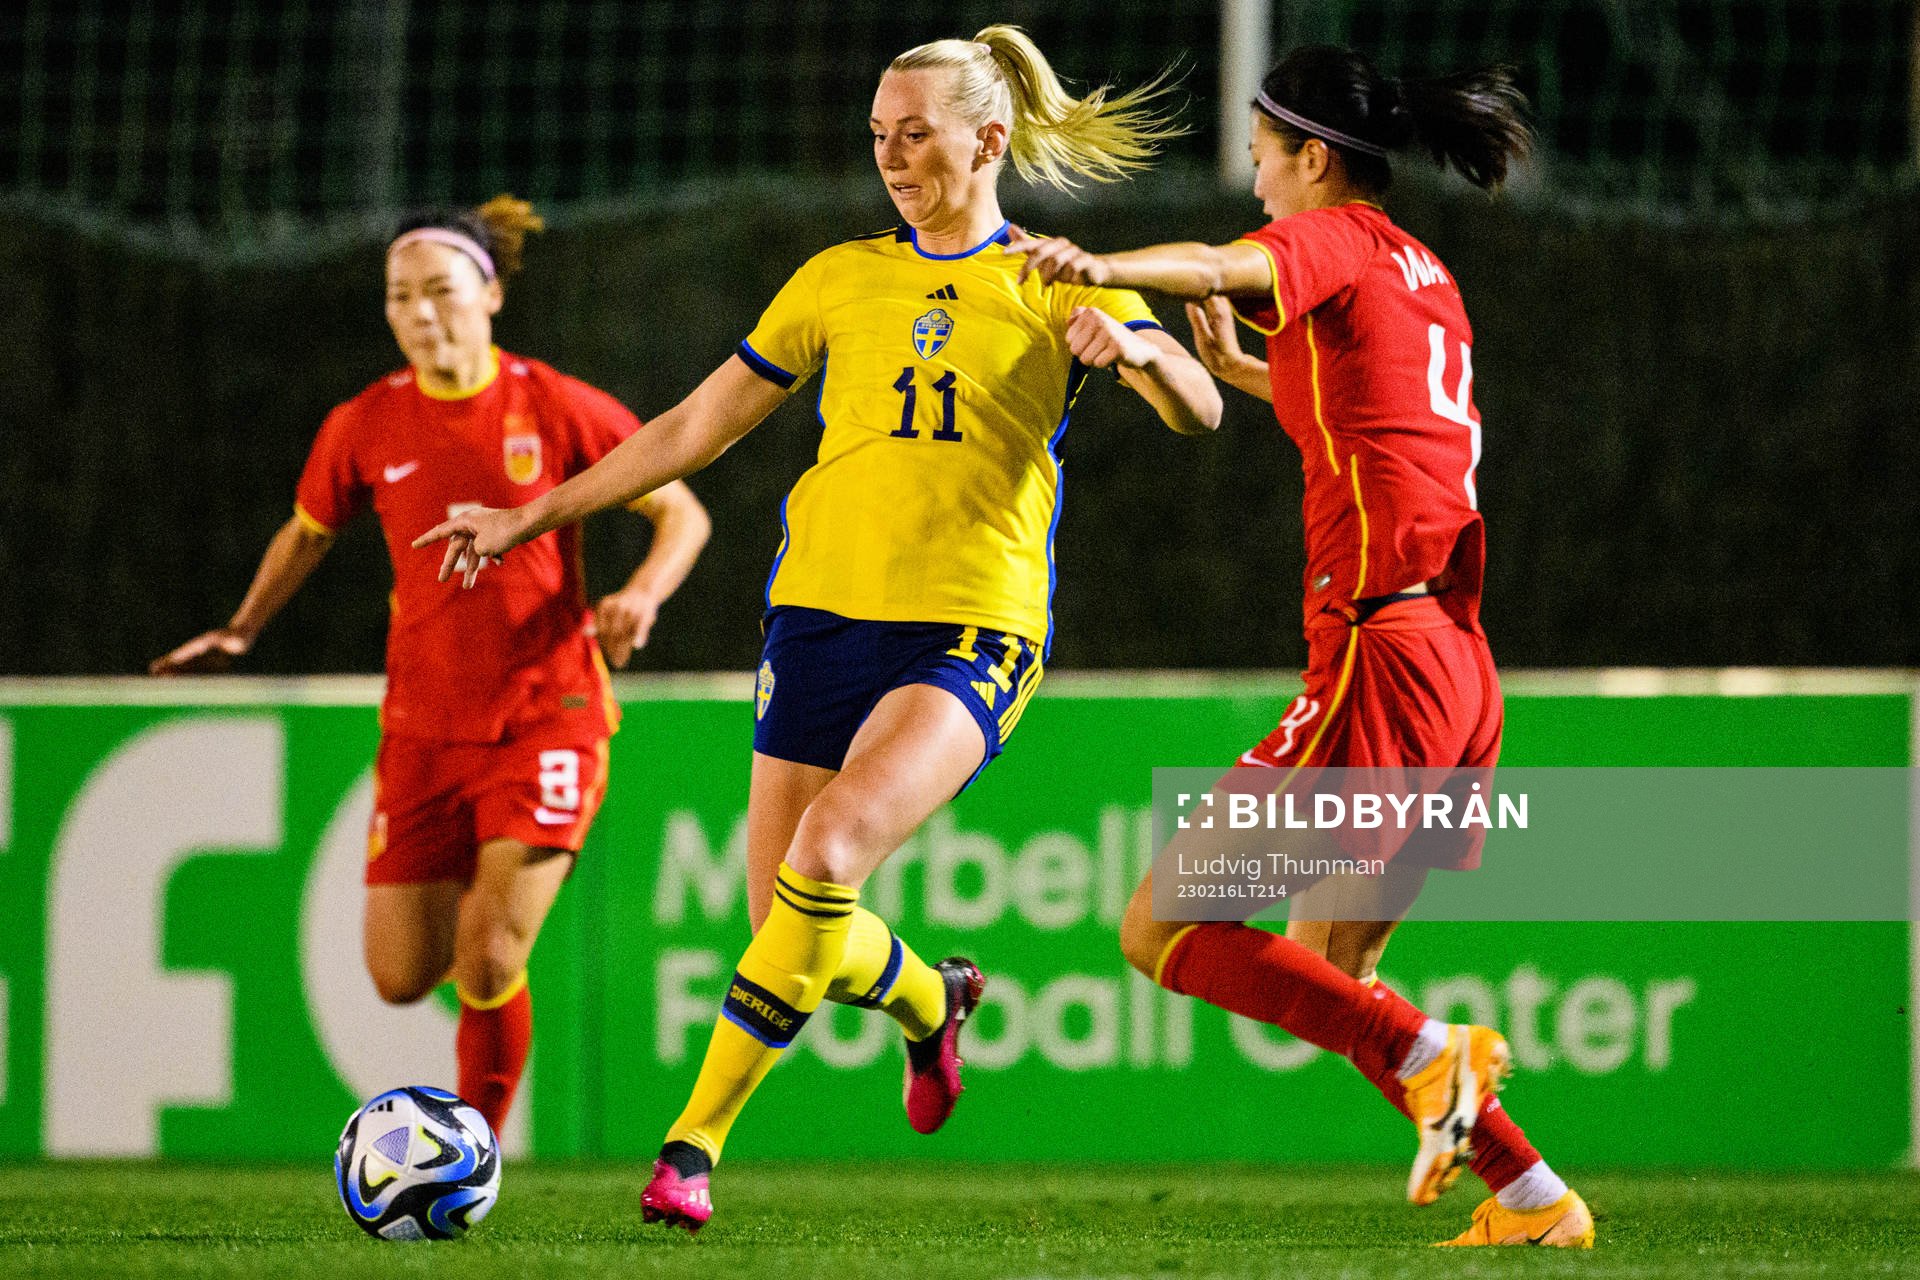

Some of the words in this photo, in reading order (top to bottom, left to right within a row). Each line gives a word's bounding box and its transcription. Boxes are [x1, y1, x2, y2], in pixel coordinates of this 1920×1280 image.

[889, 366, 963, 443] 11
[1427, 323, 1482, 511] 4
[945, 626, 1022, 694] 11
[1273, 696, 1319, 758] 4
[654, 800, 1170, 928] Mrbell
[730, 984, 793, 1031] SVERIGE
